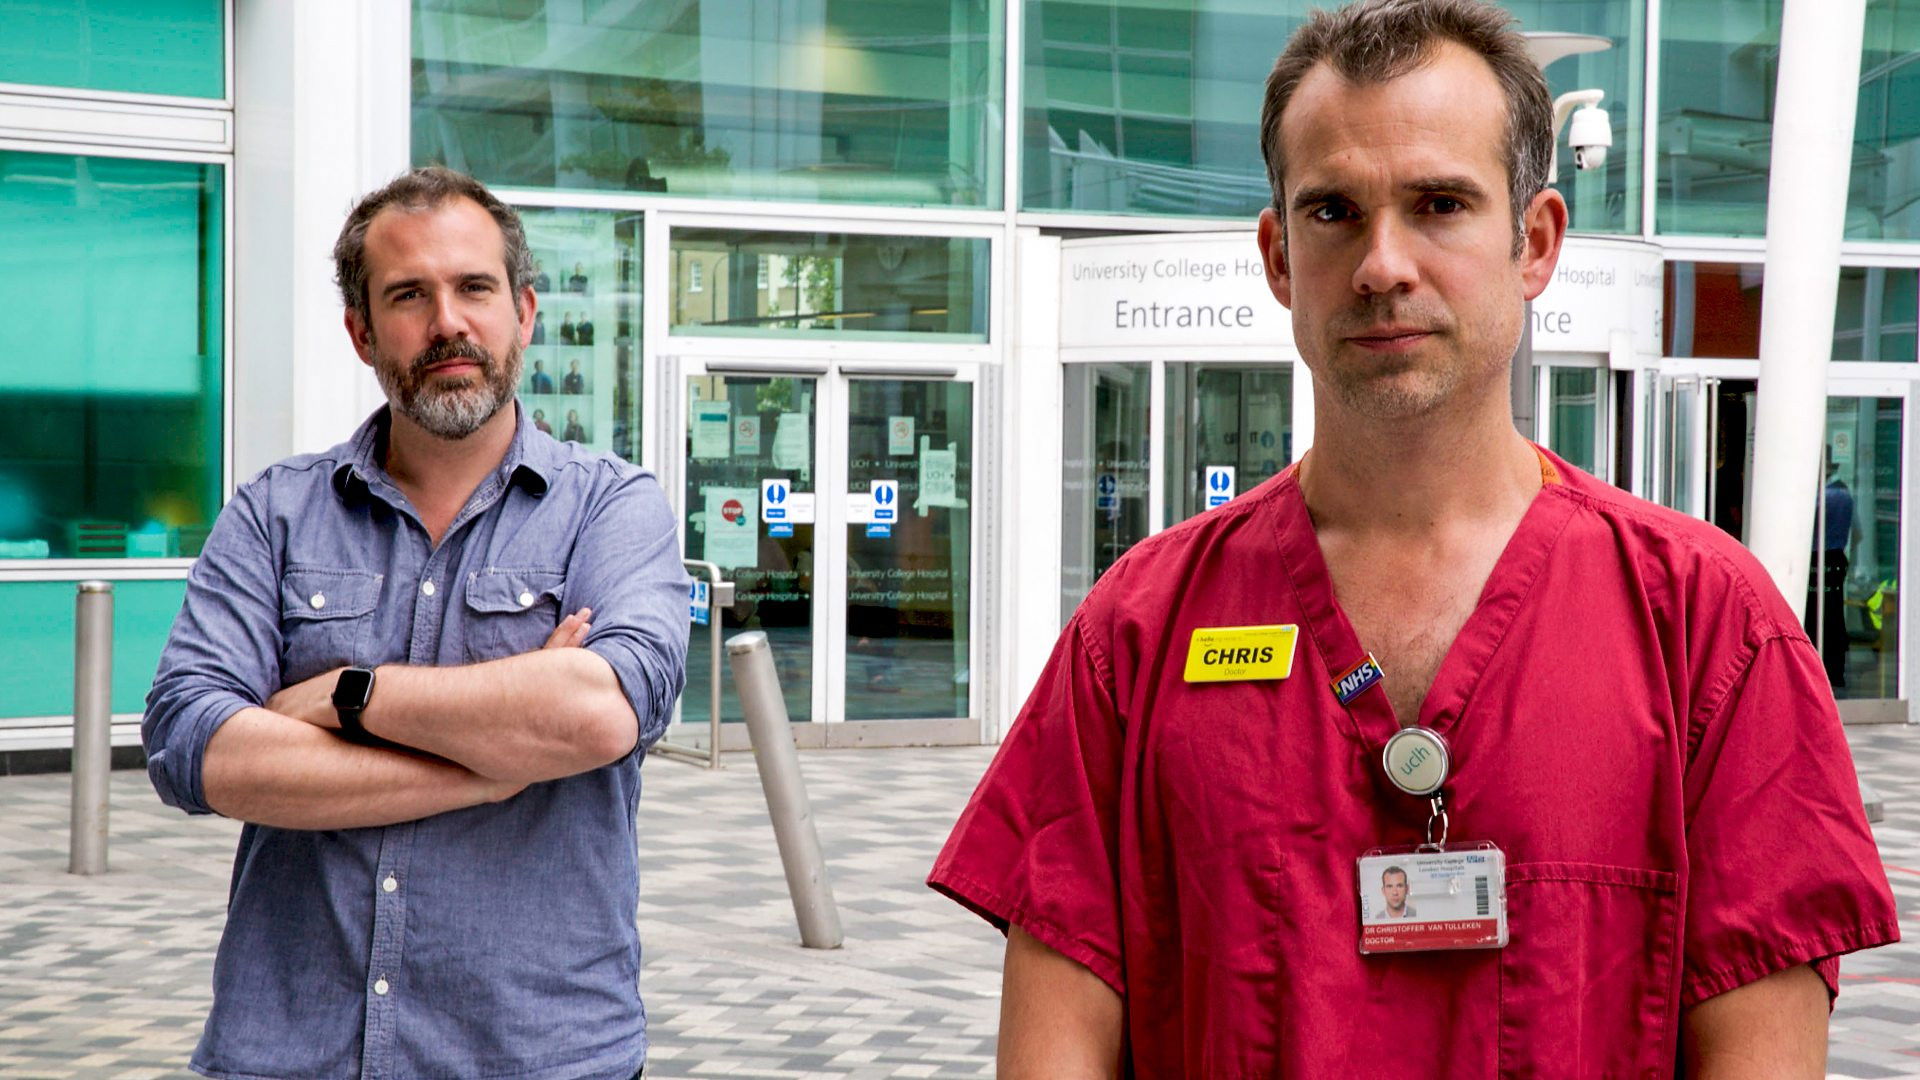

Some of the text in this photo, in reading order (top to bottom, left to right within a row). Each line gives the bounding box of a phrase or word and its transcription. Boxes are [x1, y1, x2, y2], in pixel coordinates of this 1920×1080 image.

[1072, 258, 1264, 283] University College Ho
[1557, 266, 1616, 290] Hospital
[1115, 300, 1254, 328] Entrance
[1531, 310, 1572, 334] nce
[723, 507, 742, 515] STOP
[847, 567, 949, 580] University College Hospital
[767, 591, 799, 603] Hospital
[847, 590, 949, 603] University College Hospital
[1203, 646, 1275, 666] CHRIS
[1224, 667, 1247, 676] Doctor
[1340, 661, 1375, 696] NHS
[1401, 746, 1431, 776] uclh
[1365, 921, 1482, 934] DR CHRISTOFFER VAN TULLEKEN
[1364, 936, 1395, 945] DOCTOR
